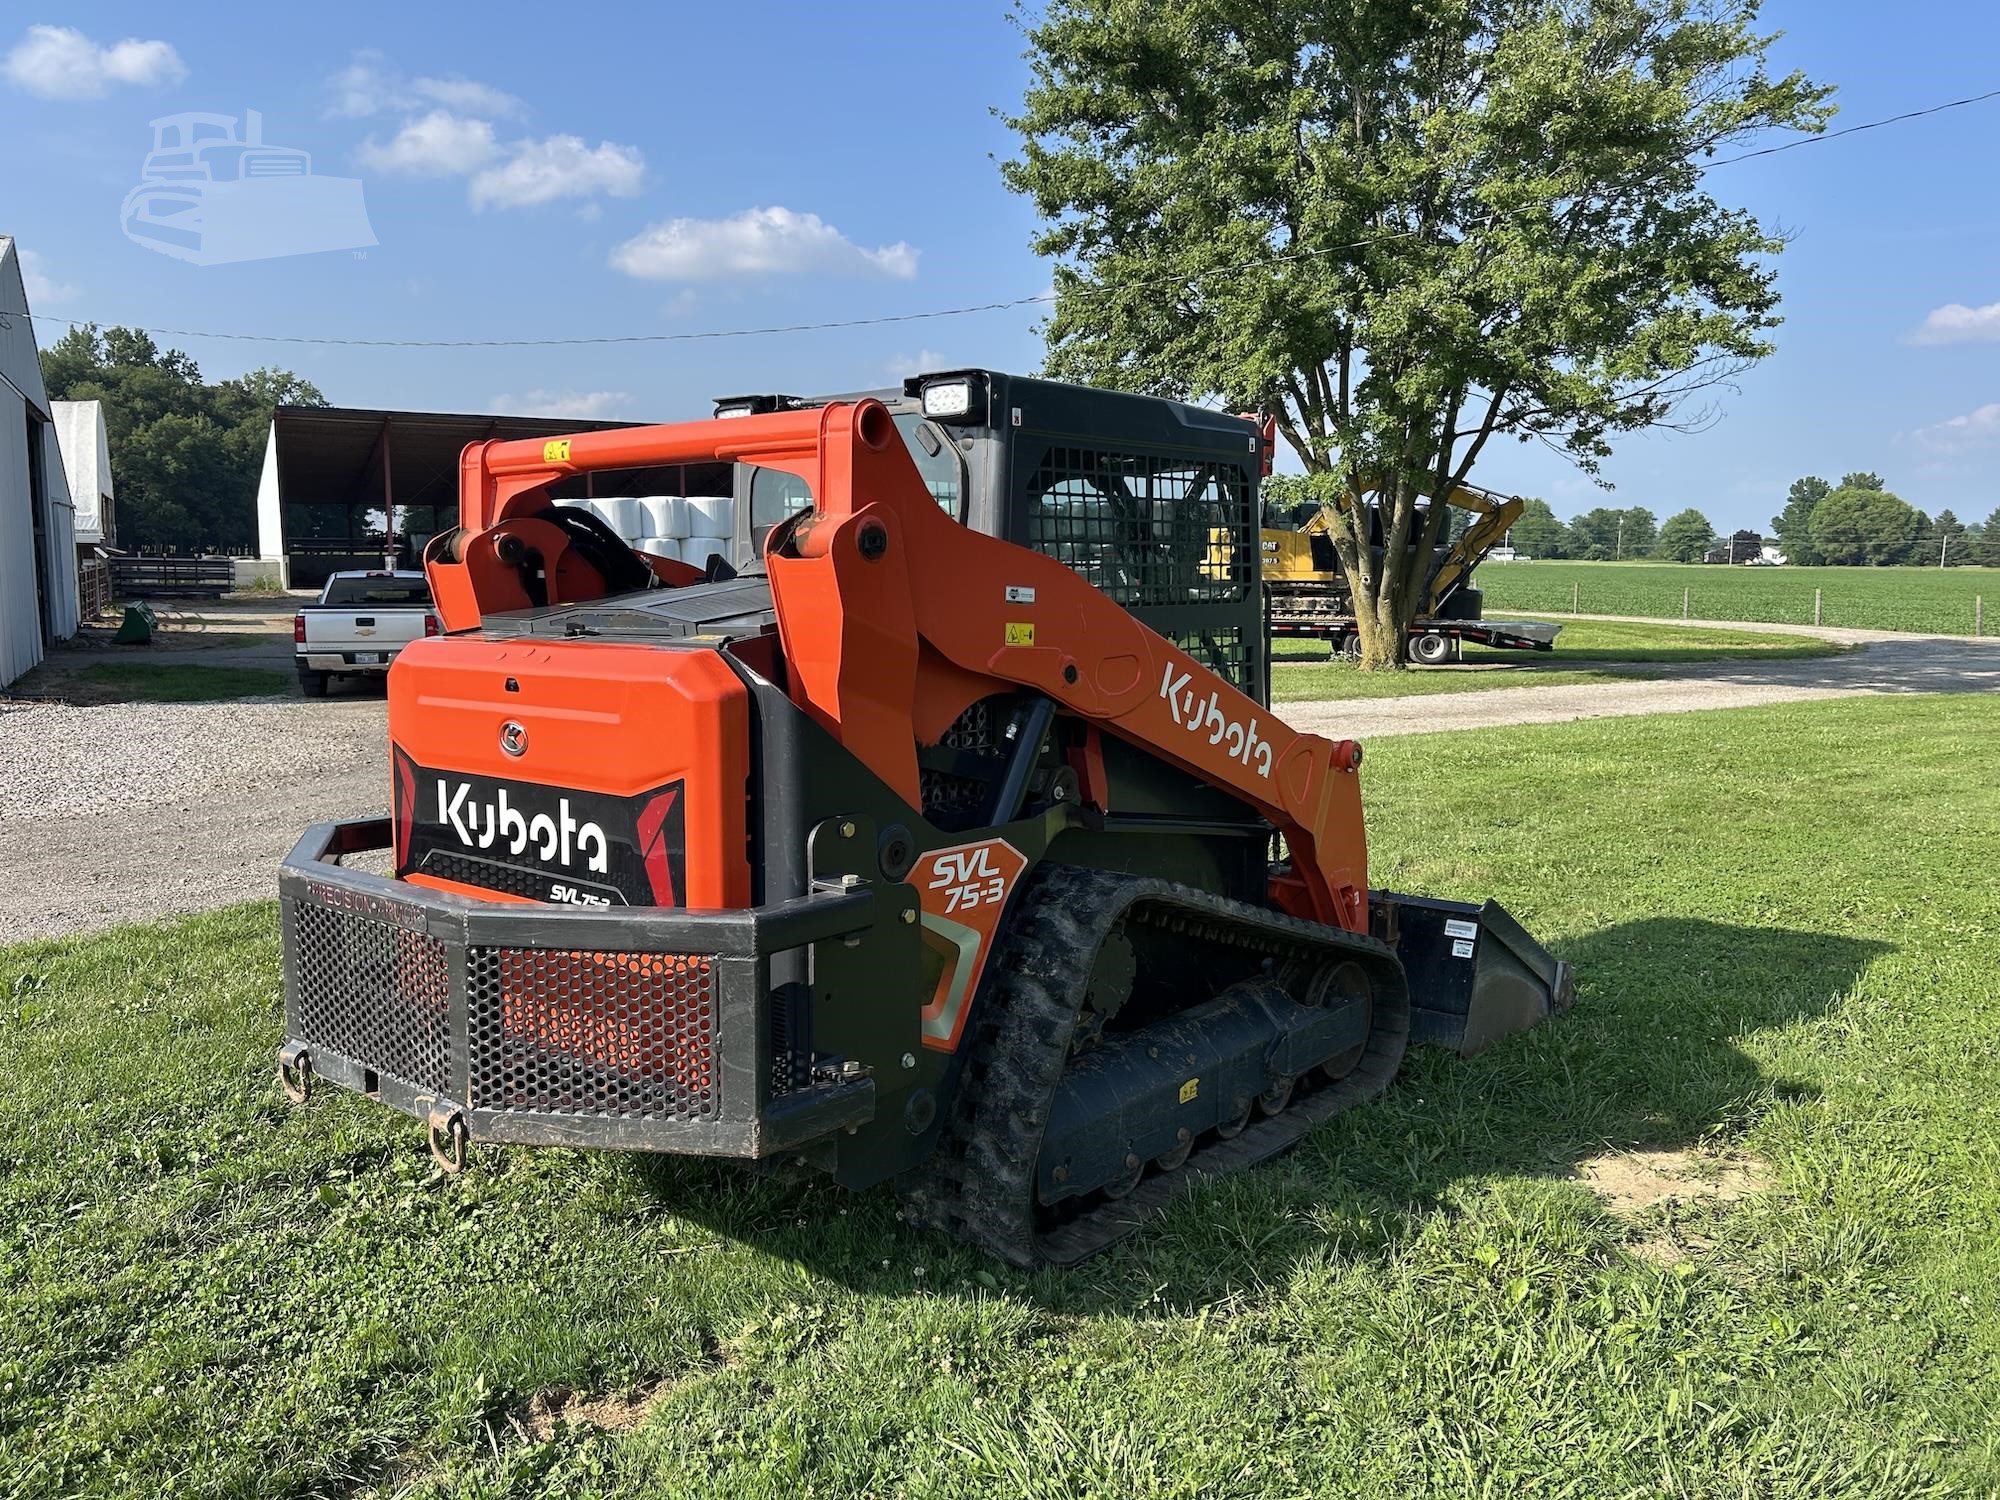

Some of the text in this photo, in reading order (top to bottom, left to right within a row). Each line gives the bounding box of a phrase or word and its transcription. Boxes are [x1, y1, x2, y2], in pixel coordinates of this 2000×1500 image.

[1262, 541, 1277, 551] CAT
[1160, 661, 1272, 779] Kubota
[437, 779, 608, 874] Kubota
[928, 847, 1000, 889] SVL
[944, 877, 1005, 914] 75-3
